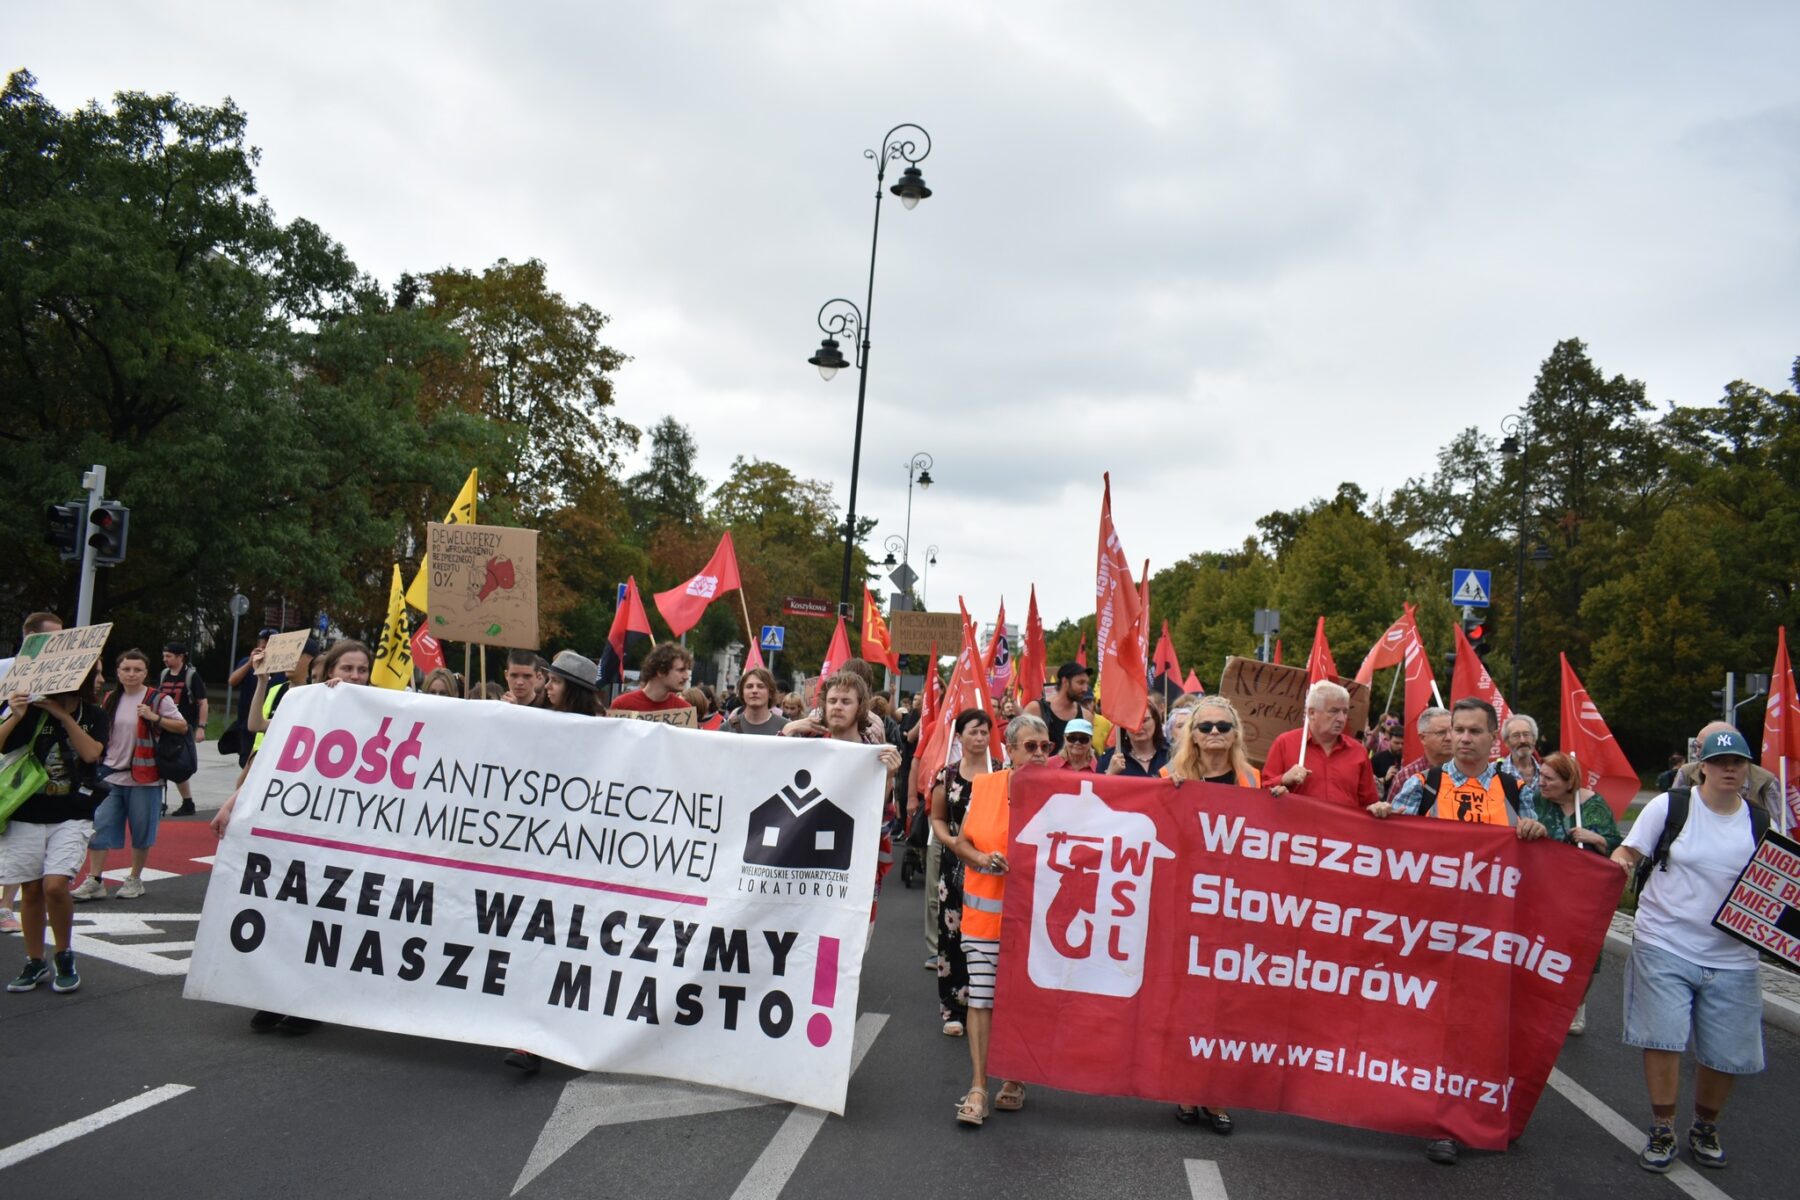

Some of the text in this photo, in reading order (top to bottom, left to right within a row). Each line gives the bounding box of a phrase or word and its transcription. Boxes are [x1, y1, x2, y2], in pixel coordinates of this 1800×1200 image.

[432, 529, 502, 548] DEWELOPERZY
[432, 562, 460, 572] KREDYTU
[434, 571, 453, 587] 0%
[790, 601, 827, 612] Koszykowa
[275, 717, 723, 834] DOŚĆ ANTYSPOŁECZNEJ
[260, 778, 718, 882] POLITYKI MIESZKANIOWEJ
[1198, 812, 1522, 898] Warszawskie
[738, 877, 848, 899] LOKATORÓW
[741, 865, 849, 883] WIELKOPOLSKIE STOWARZYSZENIE
[1745, 863, 1780, 892] NIE
[239, 852, 799, 977] RAZEM WALCZYMY
[1732, 884, 1782, 921] MIEĆ
[1191, 873, 1572, 984] Stowarzyszenie
[229, 908, 266, 953] O
[304, 920, 511, 996] NASZE
[1187, 935, 1438, 1010] Lokatorów
